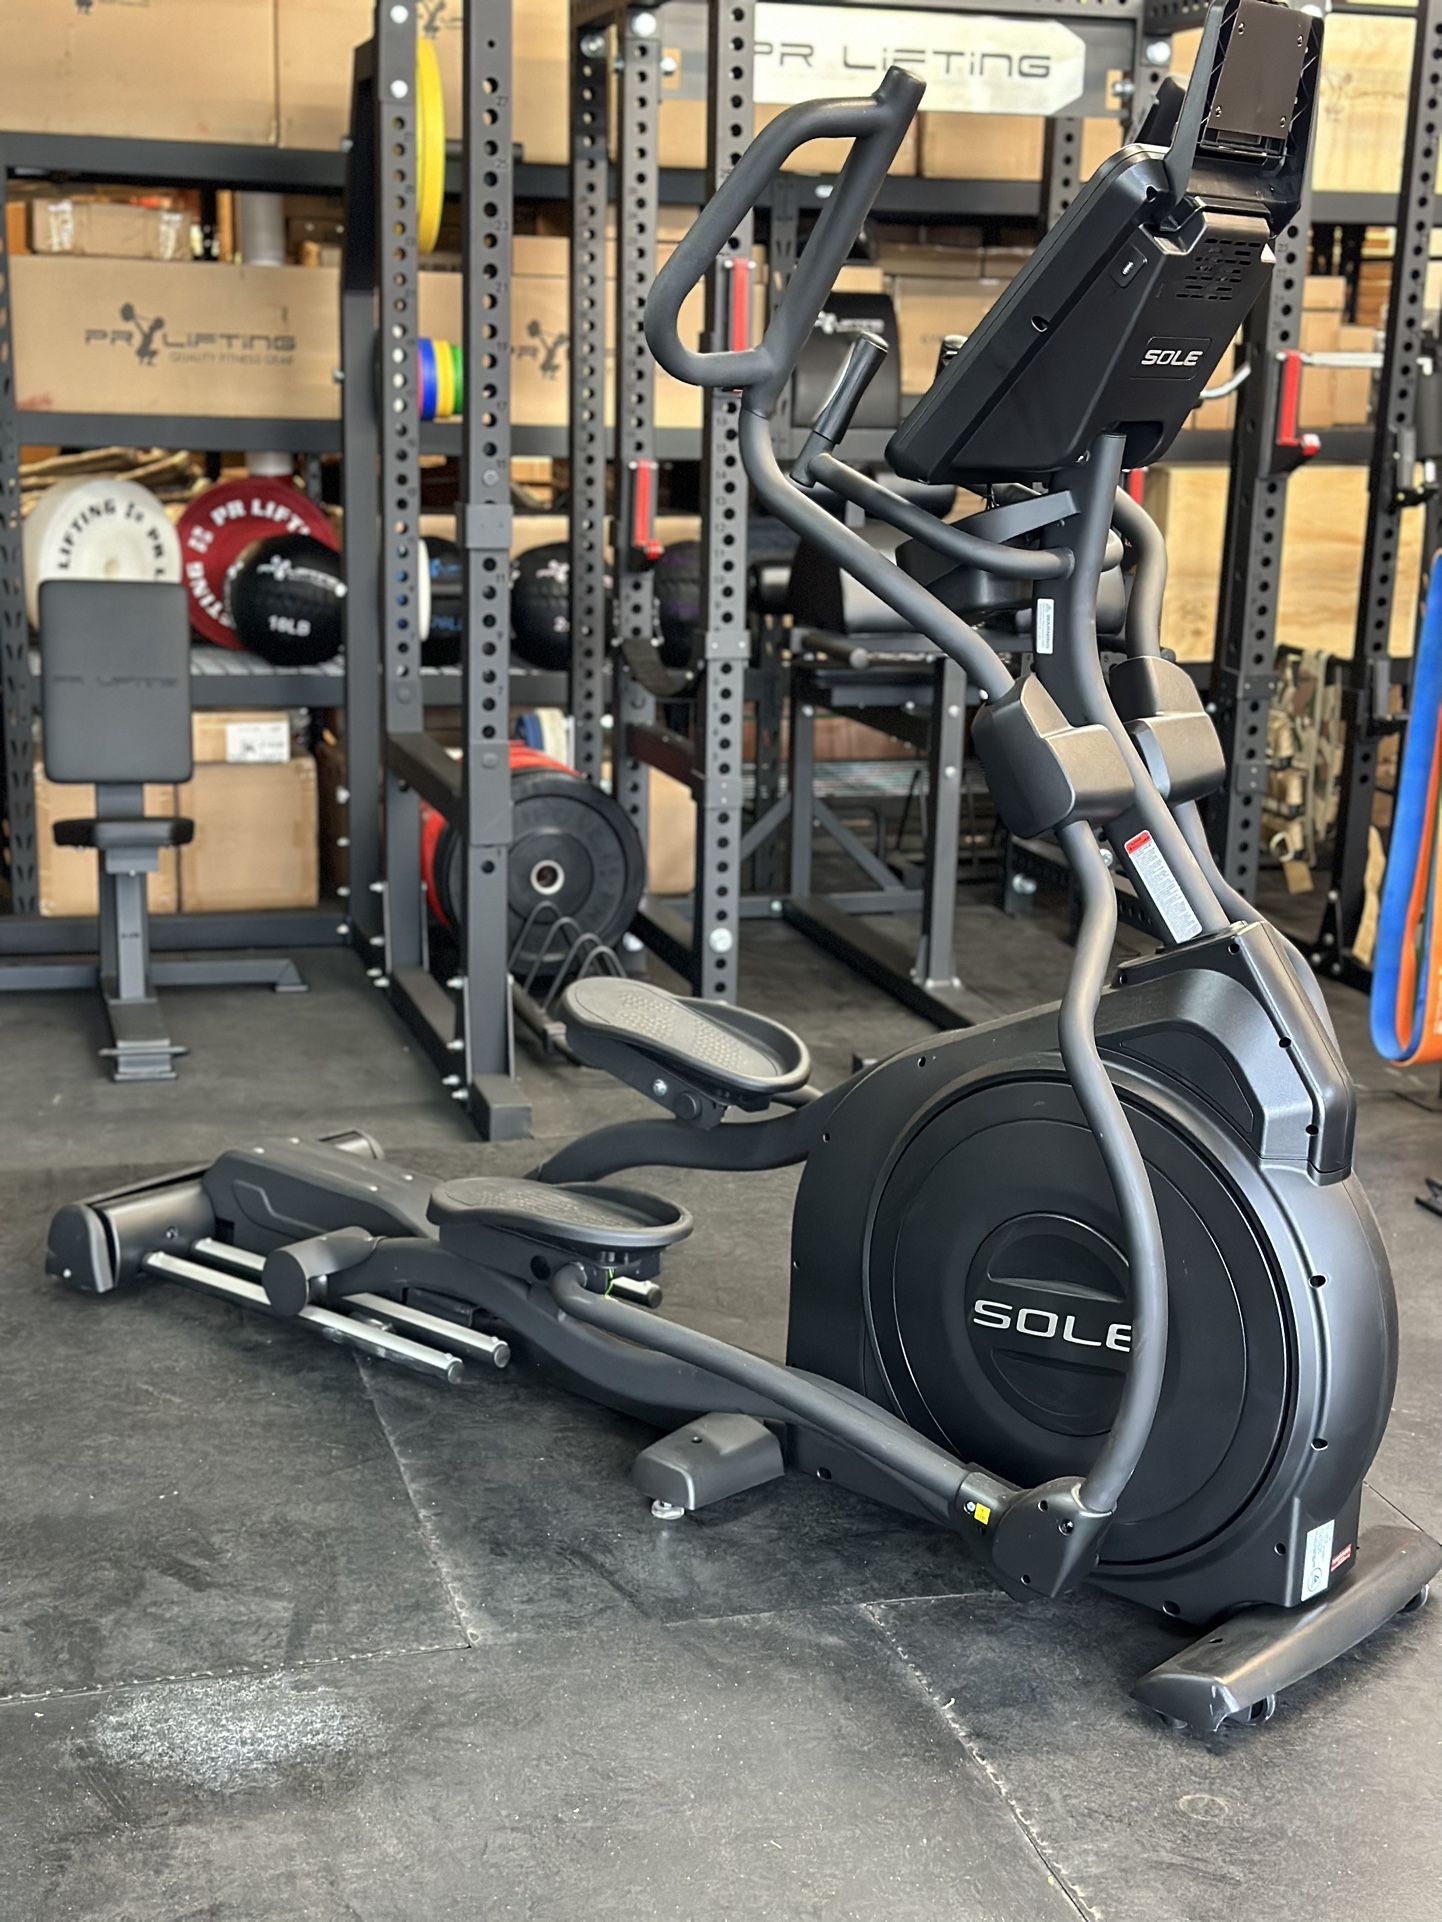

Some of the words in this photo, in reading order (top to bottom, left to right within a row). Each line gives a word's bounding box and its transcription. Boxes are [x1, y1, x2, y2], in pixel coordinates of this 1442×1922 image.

[84, 328, 134, 346] PR
[1141, 349, 1204, 366] SOLE
[58, 498, 117, 570] LIFTING
[210, 499, 246, 527] PR
[251, 498, 311, 536] LIFT
[973, 1299, 1133, 1353] SOLE
